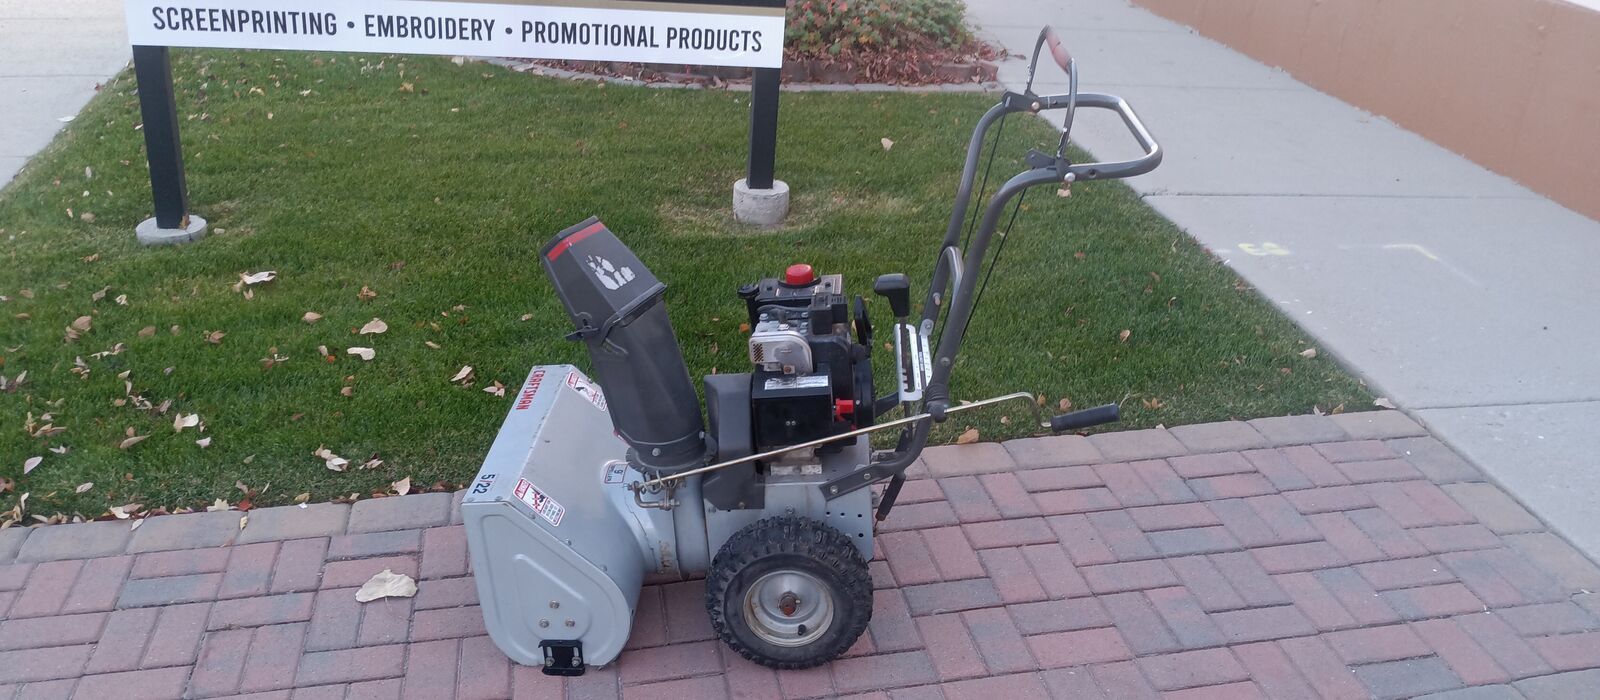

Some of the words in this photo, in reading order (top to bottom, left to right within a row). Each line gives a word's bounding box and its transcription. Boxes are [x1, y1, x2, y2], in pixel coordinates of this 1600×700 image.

[152, 6, 337, 36] SCREENPRINTING
[365, 14, 495, 41] EMBROIDERY
[522, 20, 660, 48] PROMOTIONAL
[666, 27, 763, 52] PRODUCTS
[515, 370, 546, 410] CRAFTSMAN
[472, 474, 496, 494] 5/22
